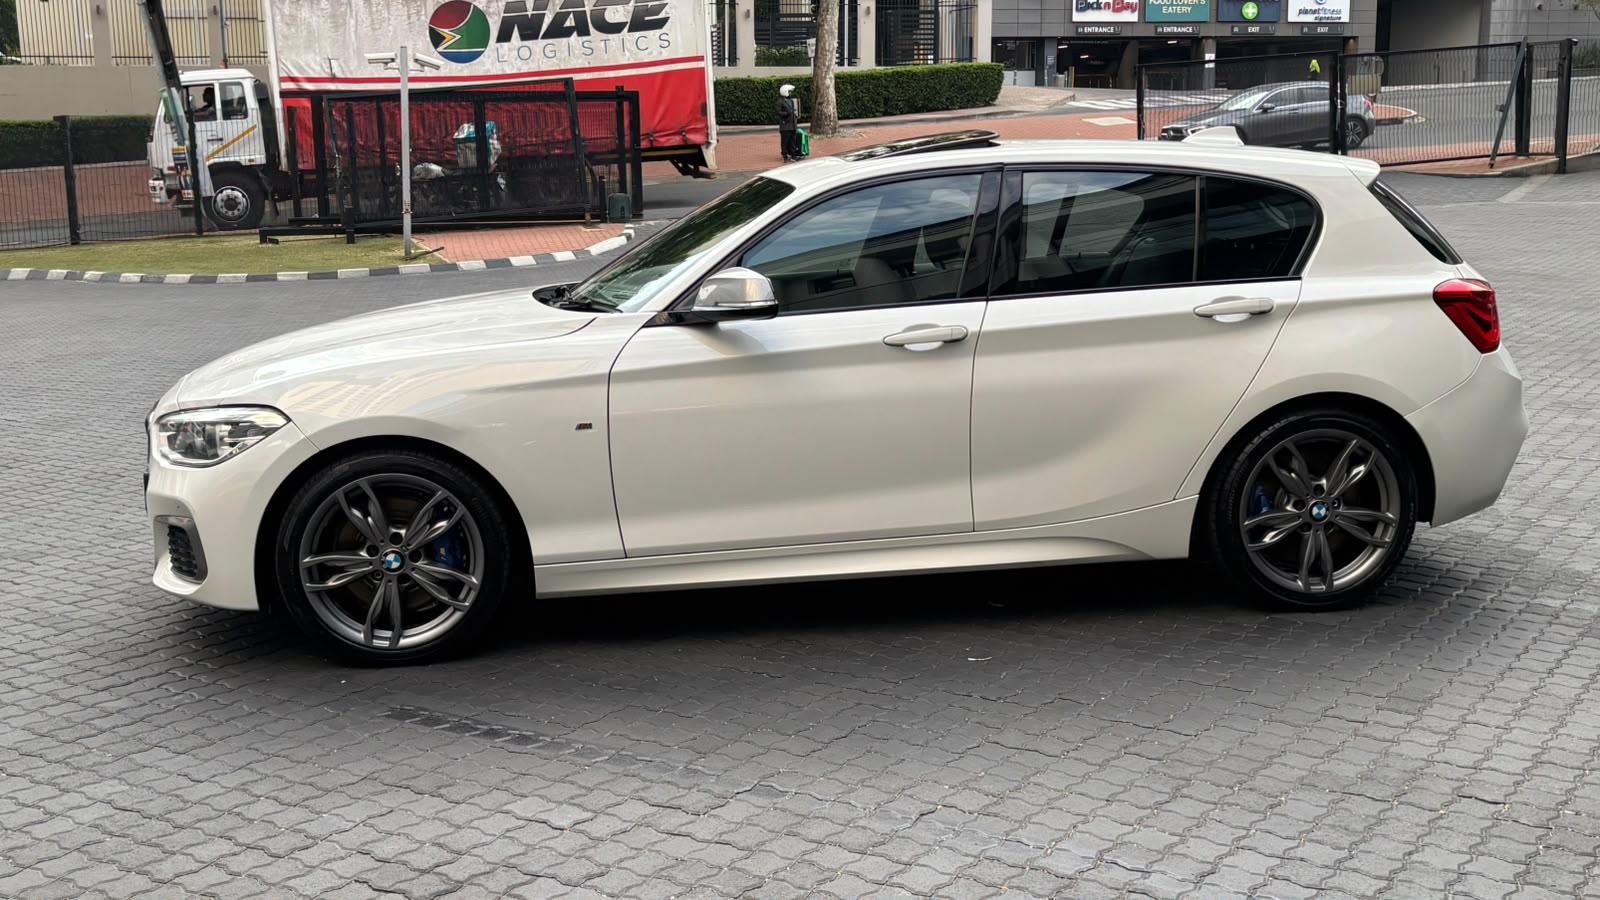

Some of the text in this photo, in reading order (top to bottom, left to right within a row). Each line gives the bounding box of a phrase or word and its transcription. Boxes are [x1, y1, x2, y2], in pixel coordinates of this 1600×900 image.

[496, 0, 671, 43] NACE
[1162, 6, 1192, 14] EATERY
[496, 32, 671, 63] LOGISTICS
